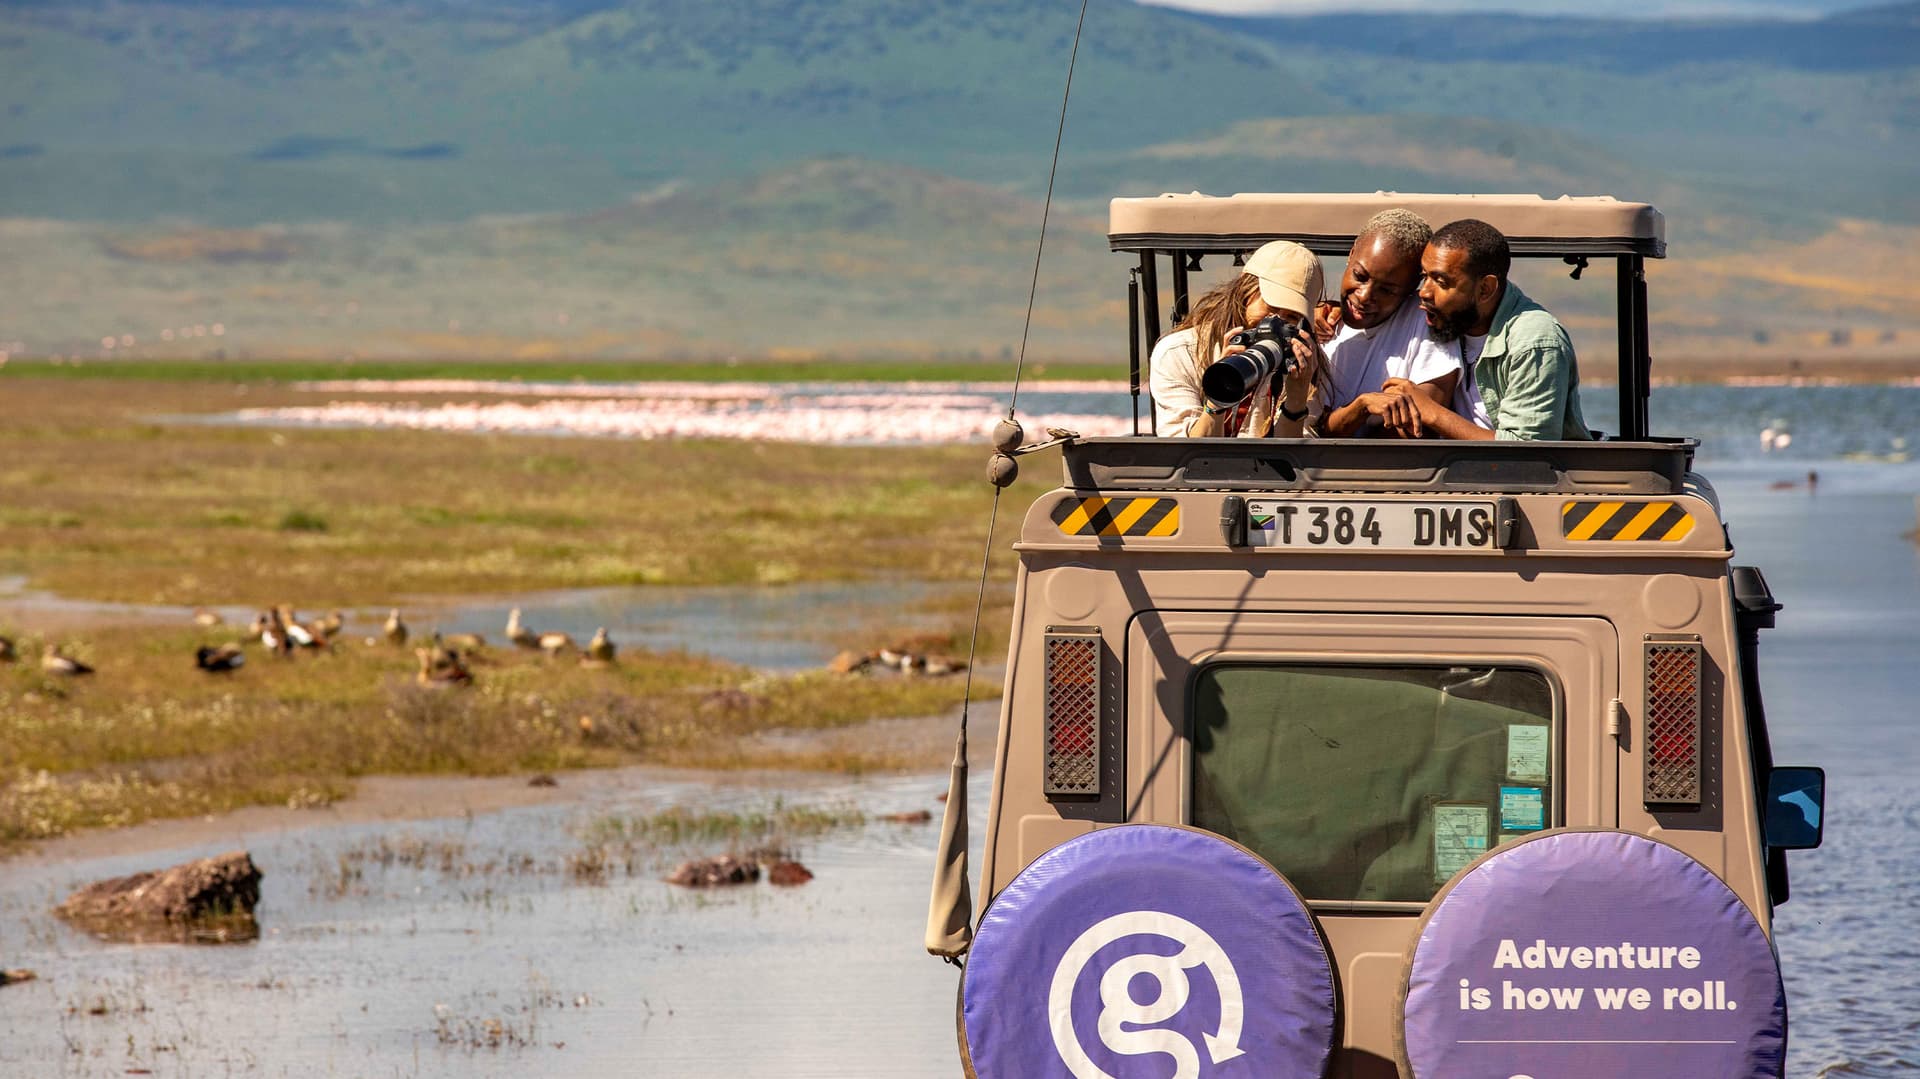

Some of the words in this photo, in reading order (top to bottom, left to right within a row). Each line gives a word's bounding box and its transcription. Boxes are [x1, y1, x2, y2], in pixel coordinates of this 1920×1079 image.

[1276, 506, 1298, 545] T
[1307, 506, 1382, 546] 384
[1413, 507, 1489, 547] DMS
[1493, 939, 1701, 969] Adventure
[1459, 978, 1492, 1011] is
[1502, 980, 1584, 1010] how
[1593, 987, 1651, 1011] we
[1663, 980, 1737, 1011] roll.
